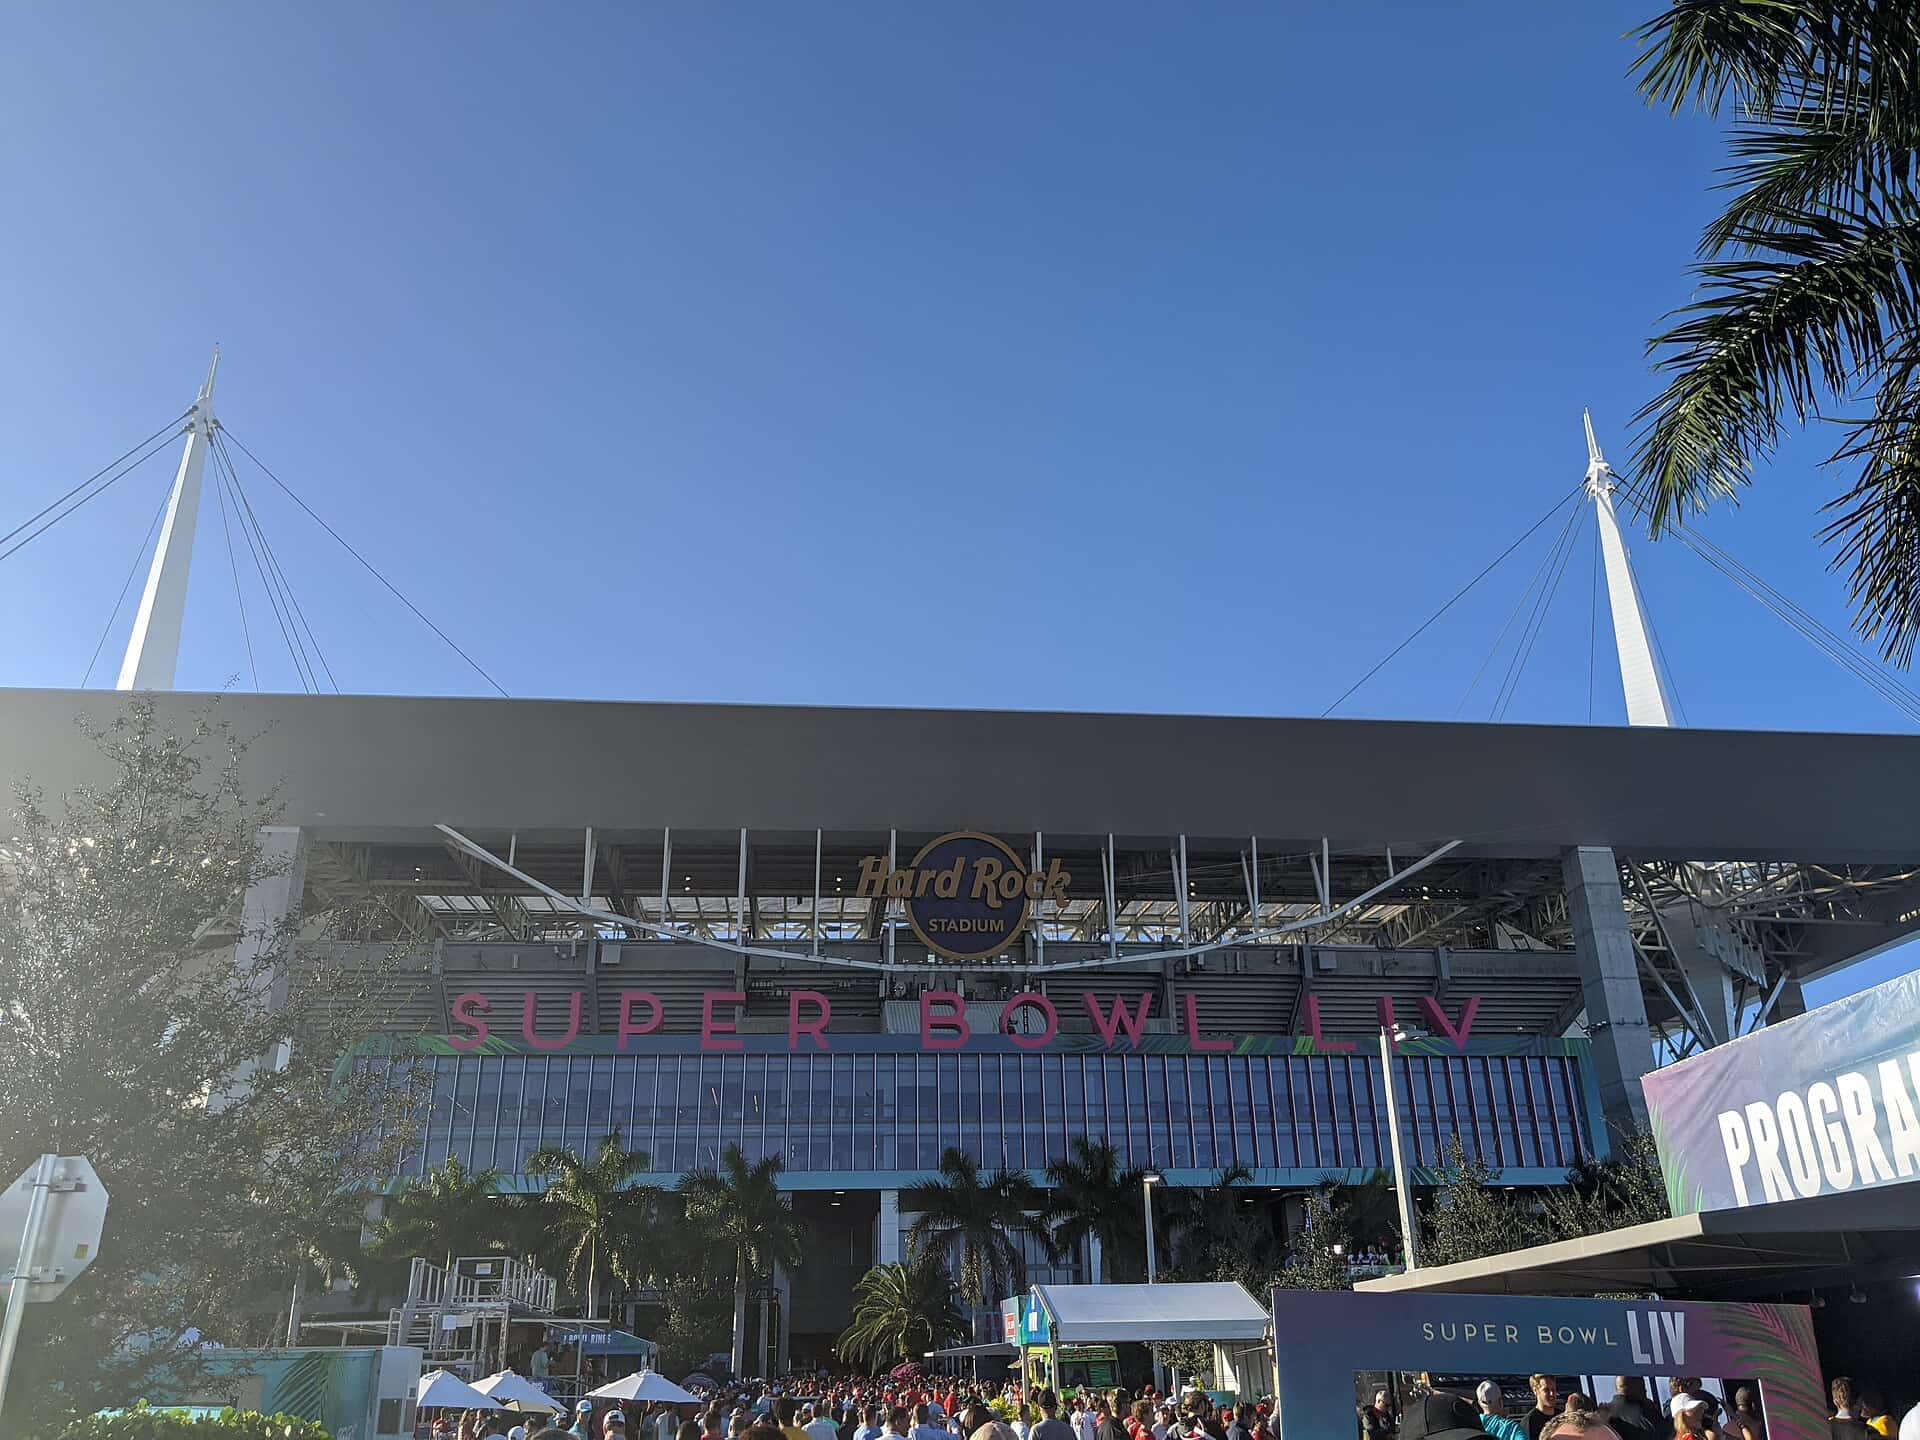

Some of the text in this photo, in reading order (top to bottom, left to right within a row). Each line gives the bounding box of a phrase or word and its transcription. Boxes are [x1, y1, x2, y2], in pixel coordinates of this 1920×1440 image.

[856, 855, 1072, 909] Hard Rock
[928, 918, 1004, 933] STADIUM
[447, 991, 1481, 1051] SUPER BOWL LIV
[1717, 1051, 1920, 1208] PROGRA
[1422, 1310, 1685, 1366] SUPER BOWL LIV
